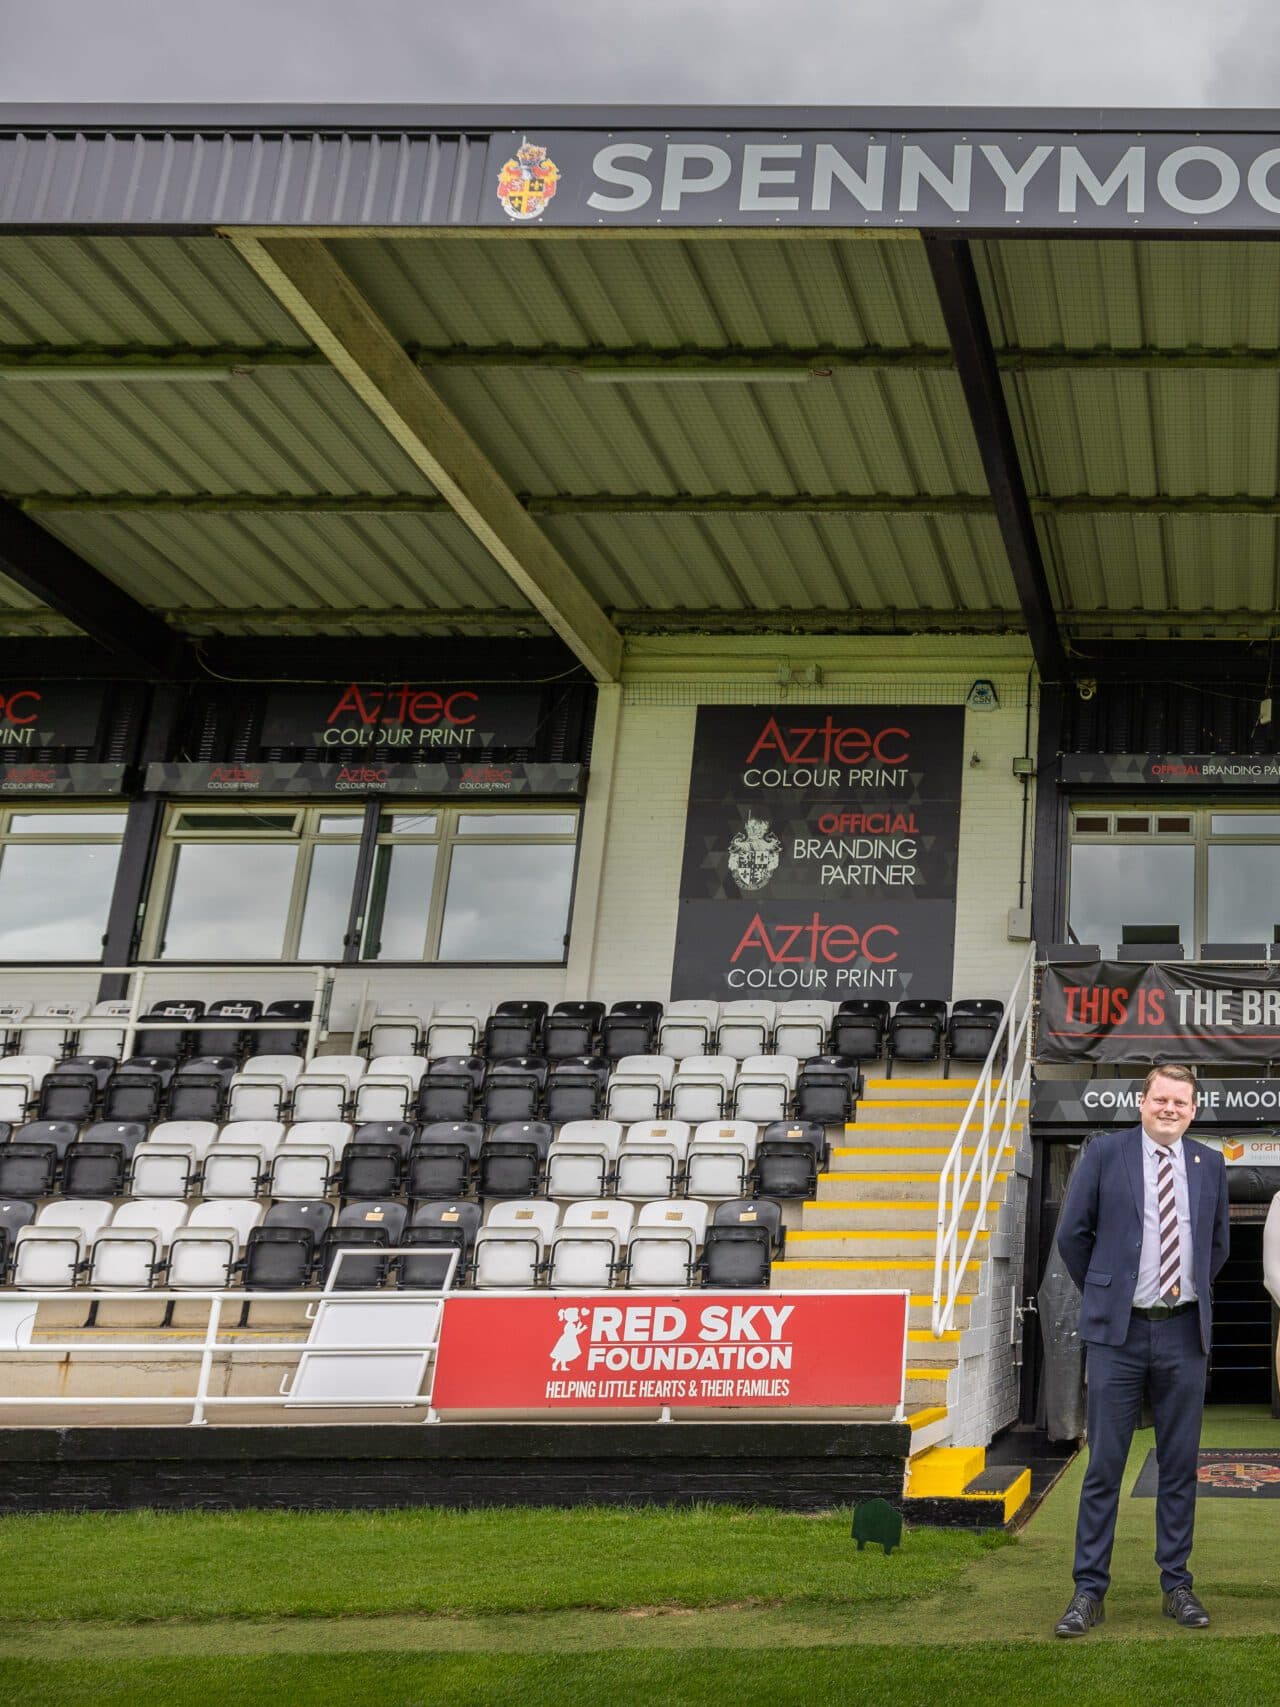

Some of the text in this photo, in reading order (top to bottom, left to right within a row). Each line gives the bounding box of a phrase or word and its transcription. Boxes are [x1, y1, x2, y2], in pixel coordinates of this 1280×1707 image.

[327, 681, 479, 725] Aztec
[0, 728, 35, 744] INT
[323, 728, 475, 745] COLOUR PRINT
[746, 716, 910, 764] Aztec
[336, 768, 387, 782] Aztec
[744, 769, 908, 787] COLOUR PRINT
[1152, 765, 1199, 775] OFFICIAL
[1202, 765, 1262, 776] BRANDING
[819, 814, 919, 834] OFFICIAL
[793, 839, 917, 859] BRANDING
[821, 865, 915, 885] PARTNER
[730, 912, 899, 963] Aztec
[727, 969, 897, 988] COLOUR PRINT
[1064, 986, 1128, 1025] THIS
[1138, 986, 1165, 1025] IS
[1175, 988, 1233, 1026] THE
[1084, 1091, 1144, 1108] COME
[1193, 1091, 1220, 1107] HE
[590, 1306, 795, 1341] RED SKY
[587, 1347, 792, 1370] FOUNDATION
[546, 1379, 789, 1398] HELPING LITTLE HEARTS & THEIR FAMILIES
